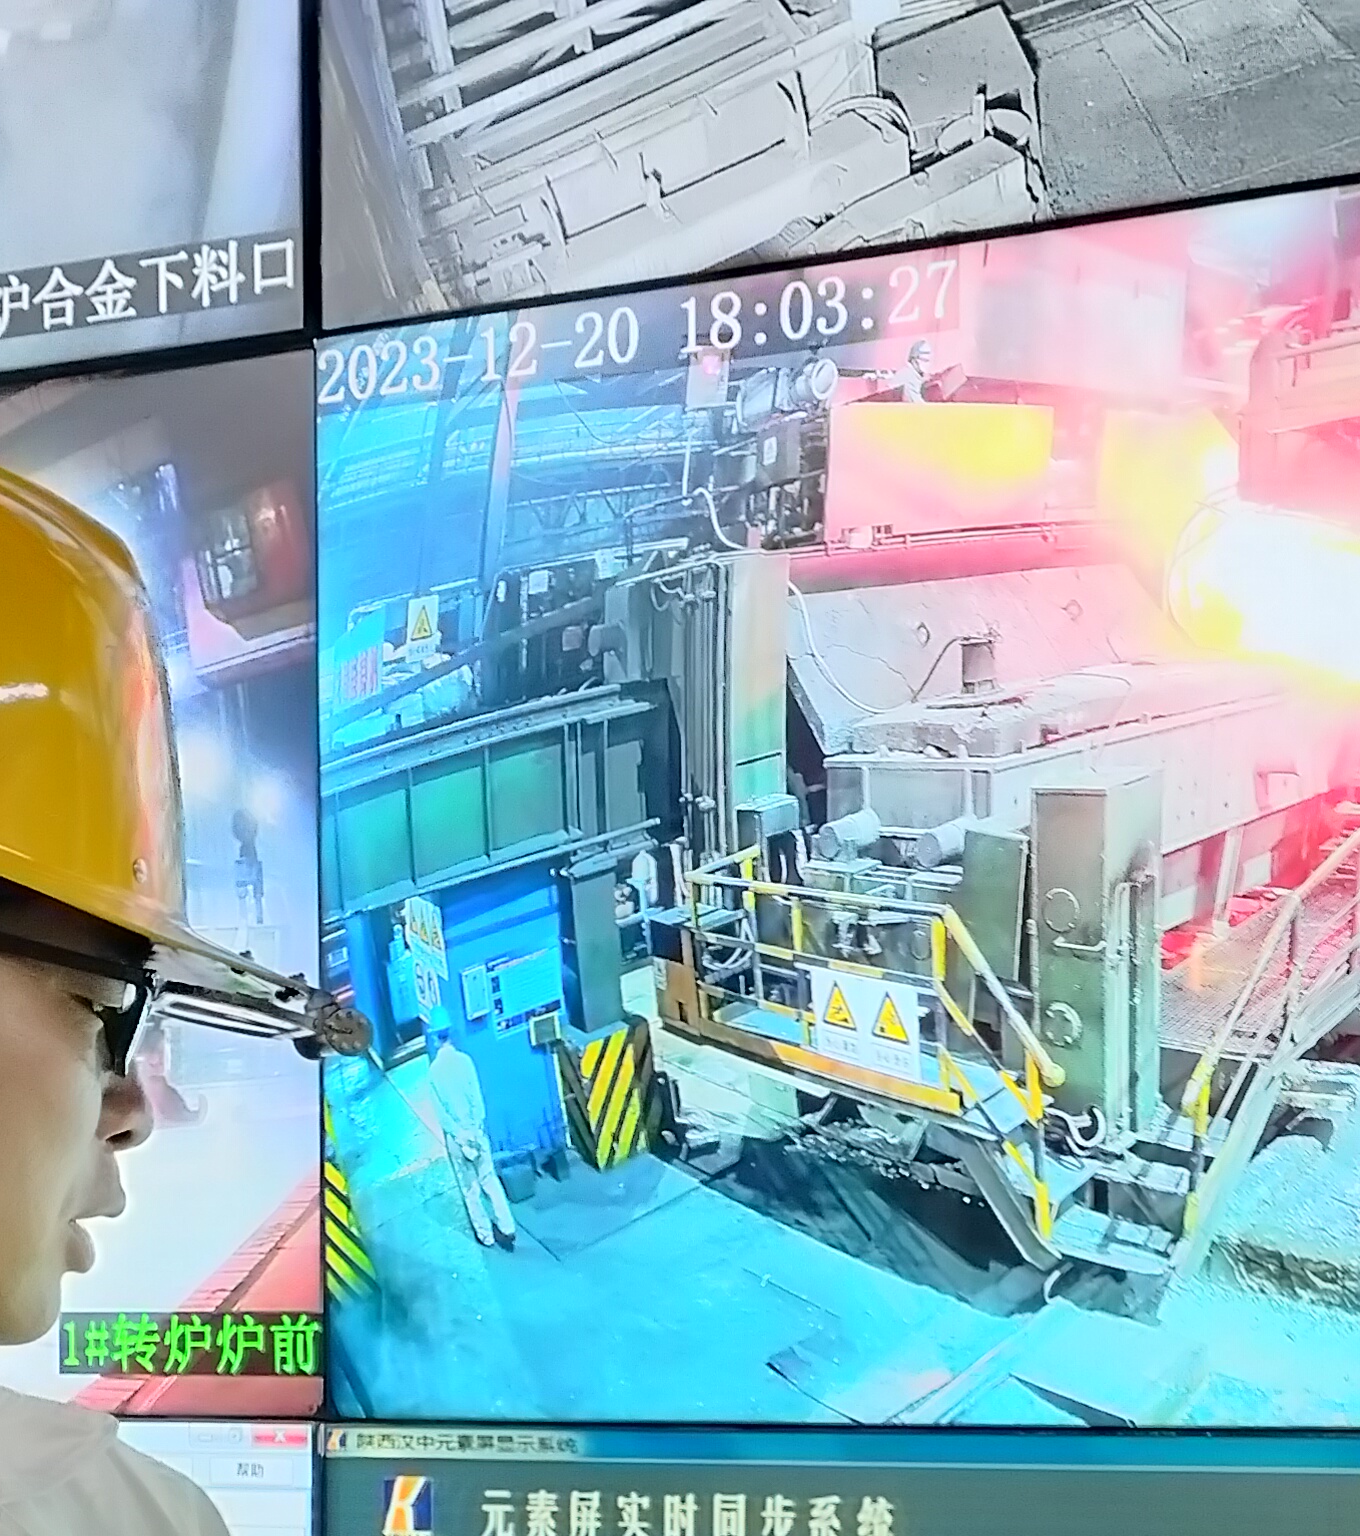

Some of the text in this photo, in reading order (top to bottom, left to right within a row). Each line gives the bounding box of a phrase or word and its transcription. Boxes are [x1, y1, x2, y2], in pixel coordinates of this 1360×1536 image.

[316, 259, 959, 403] 2023-12-20 18:03:27
[62, 1312, 323, 1375] 1#转炉炉前
